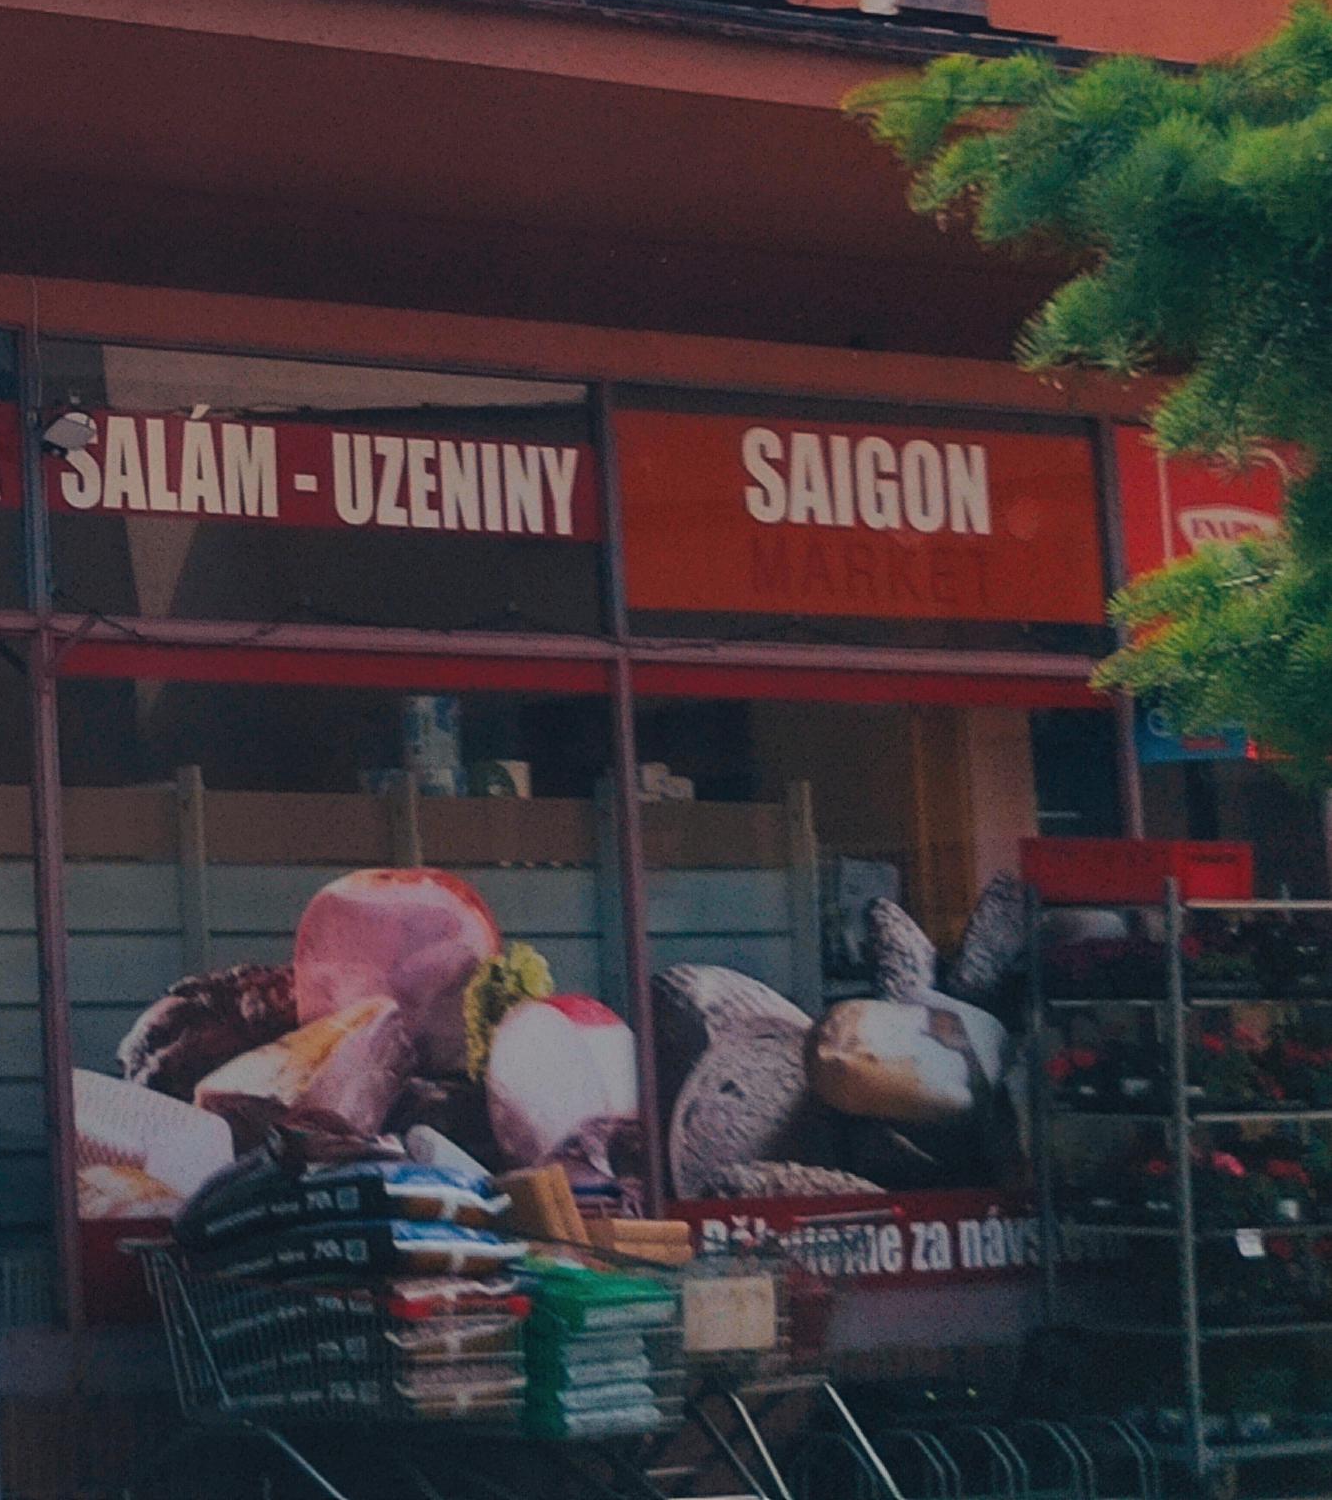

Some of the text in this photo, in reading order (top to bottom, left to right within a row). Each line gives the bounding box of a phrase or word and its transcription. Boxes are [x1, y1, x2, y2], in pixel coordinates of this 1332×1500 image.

[59, 403, 279, 518] SALÁM
[332, 432, 579, 536] UZENINY
[741, 427, 991, 536] SAIGON
[909, 1220, 953, 1272] za
